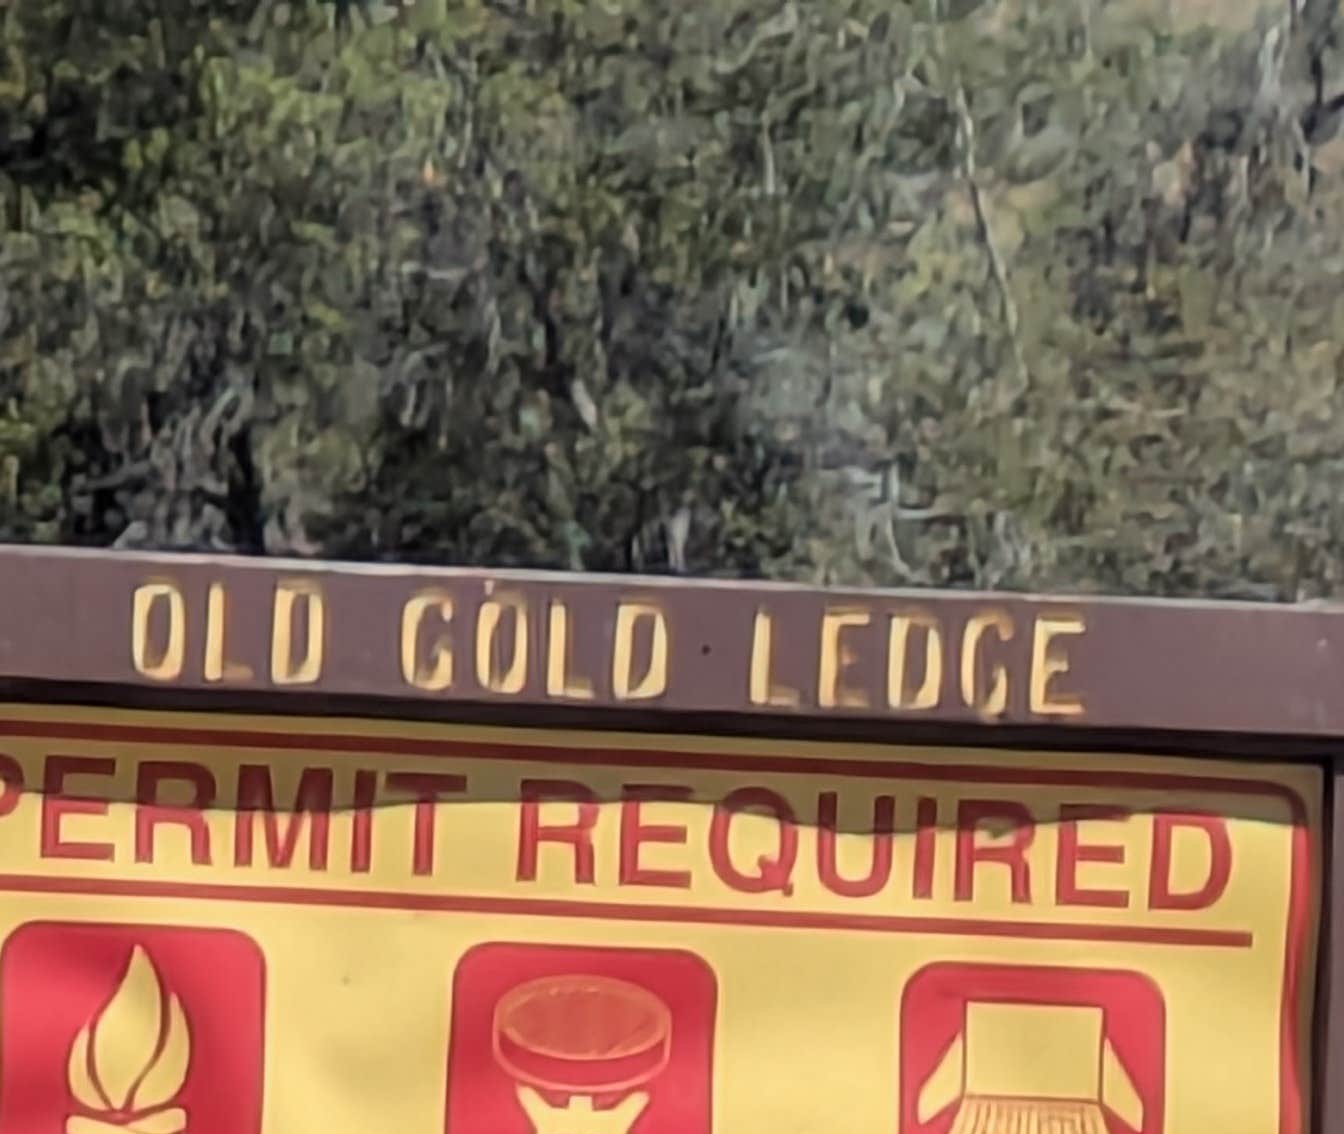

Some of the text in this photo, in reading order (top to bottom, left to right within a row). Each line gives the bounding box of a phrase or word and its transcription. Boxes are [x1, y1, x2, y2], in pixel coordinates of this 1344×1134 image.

[130, 580, 1087, 721] OLD GOLD LEDGE
[516, 778, 1235, 912] REQUIRED
